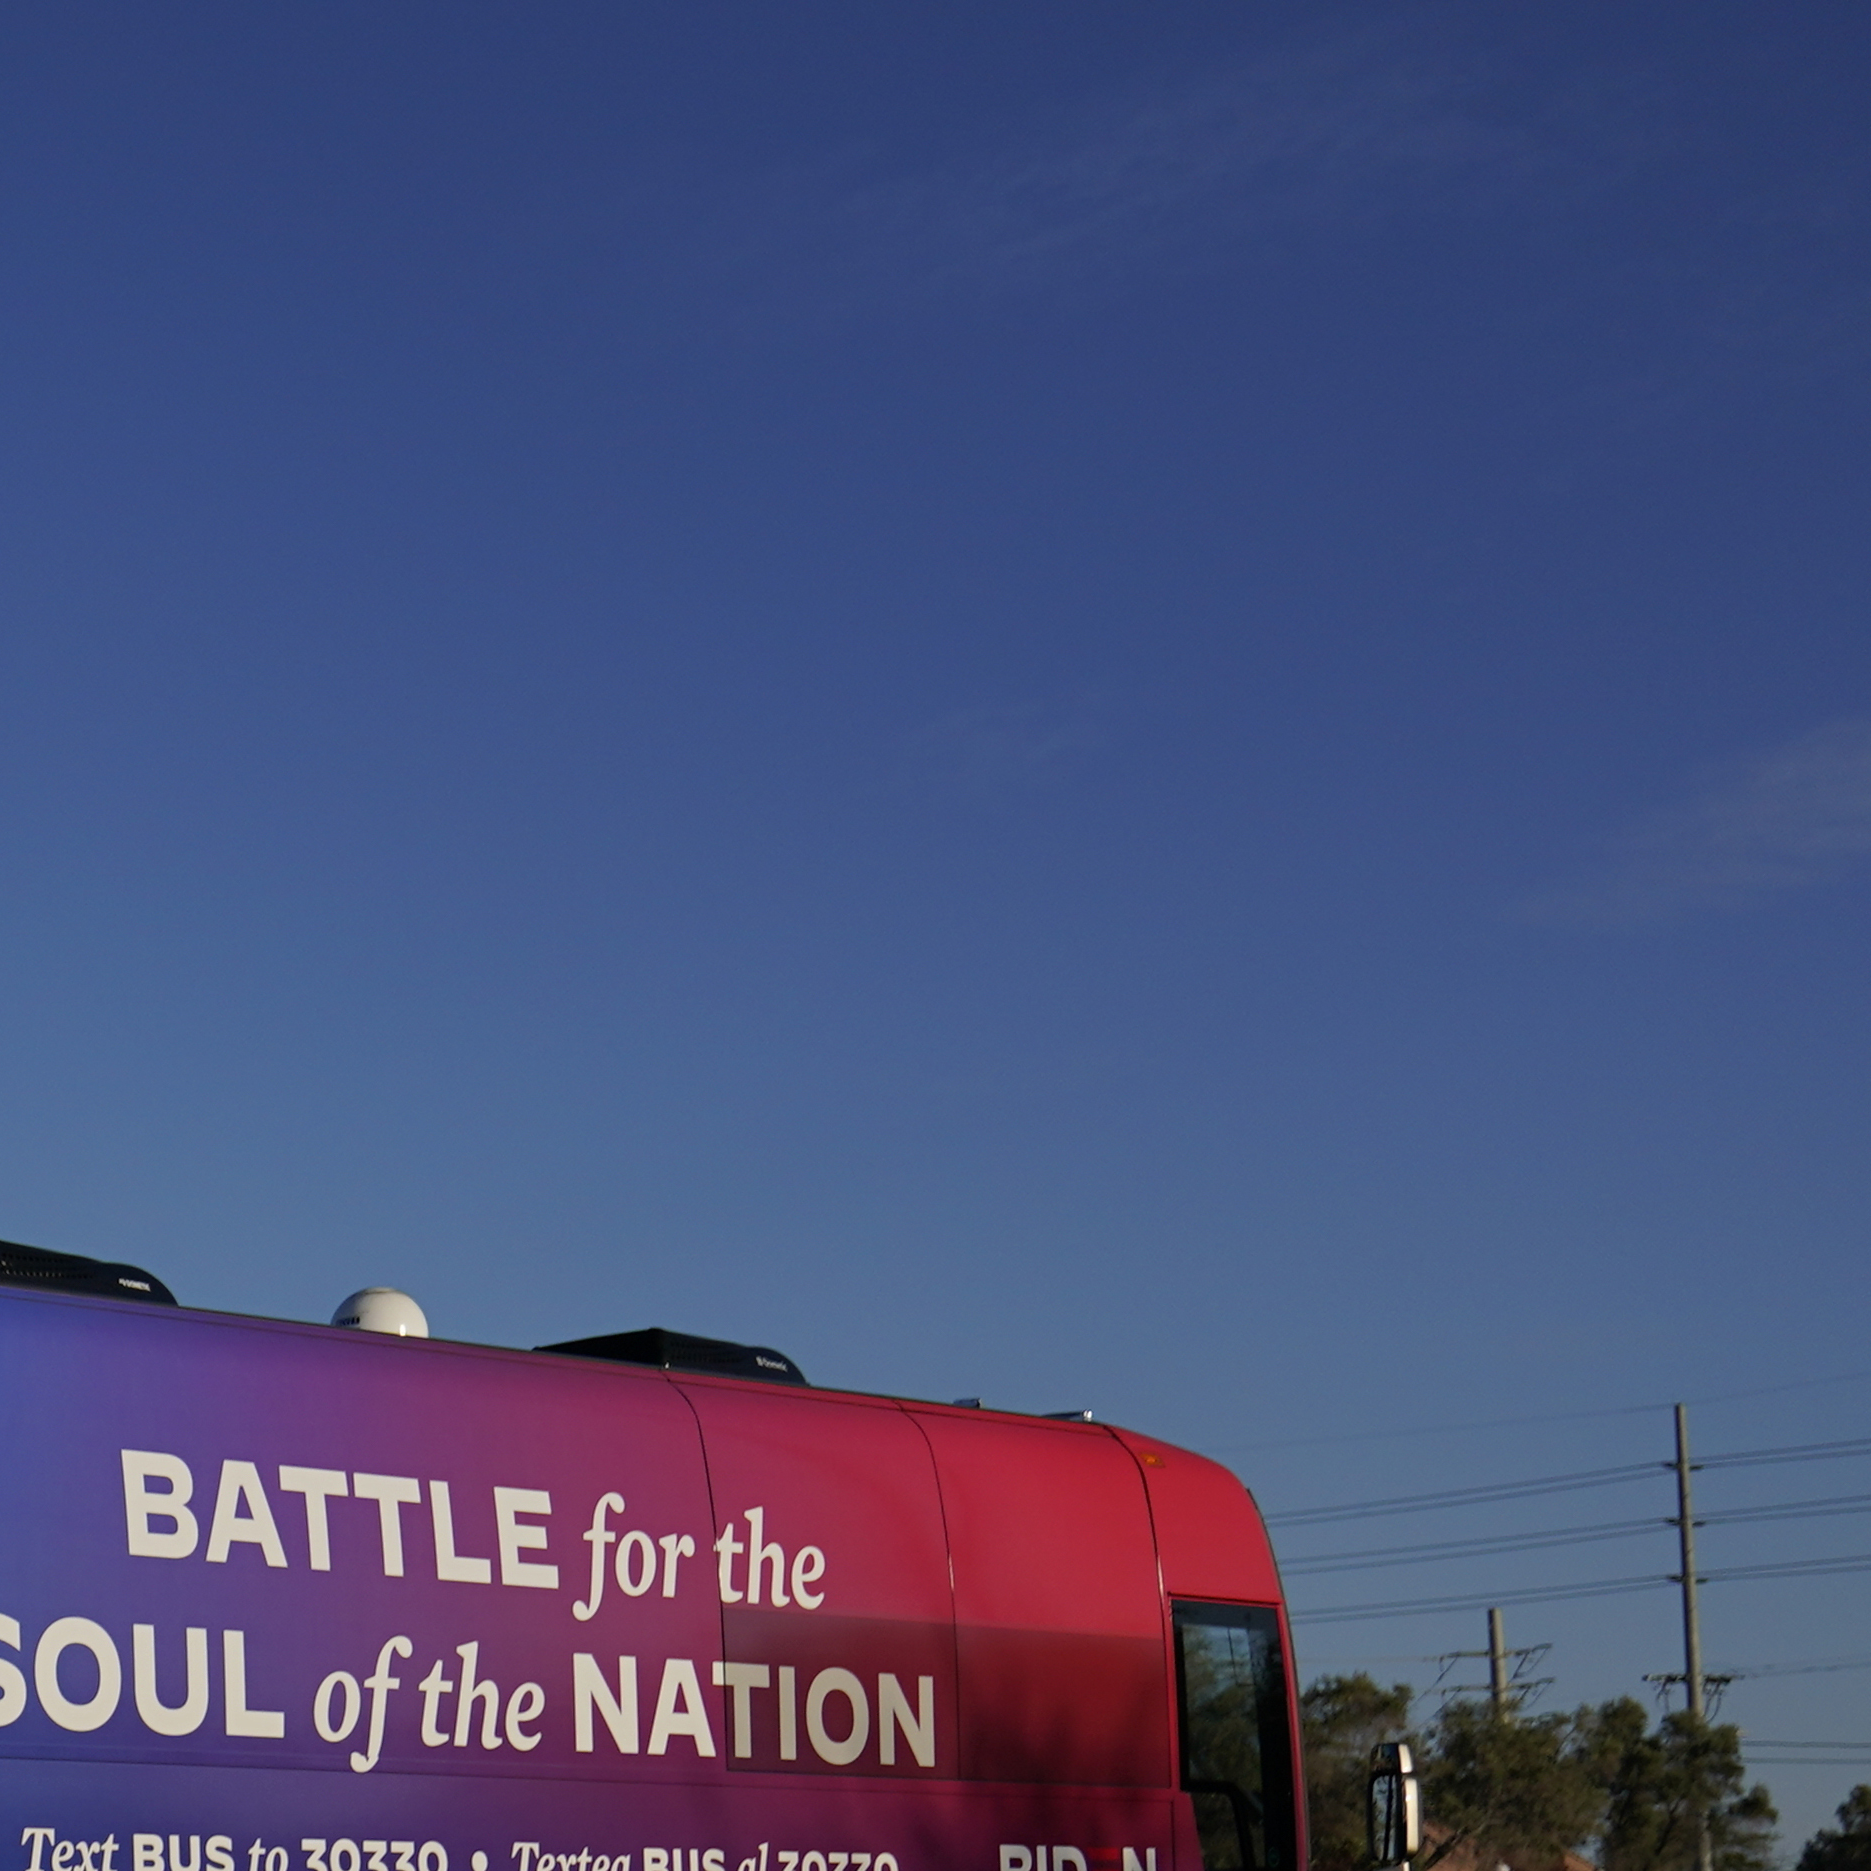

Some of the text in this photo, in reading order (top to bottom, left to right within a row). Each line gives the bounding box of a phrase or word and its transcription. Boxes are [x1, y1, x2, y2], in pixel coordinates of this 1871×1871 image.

[121, 1448, 826, 1621] BATTLE for the
[313, 1635, 414, 1773] of
[418, 1640, 546, 1752] the
[572, 1652, 937, 1769] NATION
